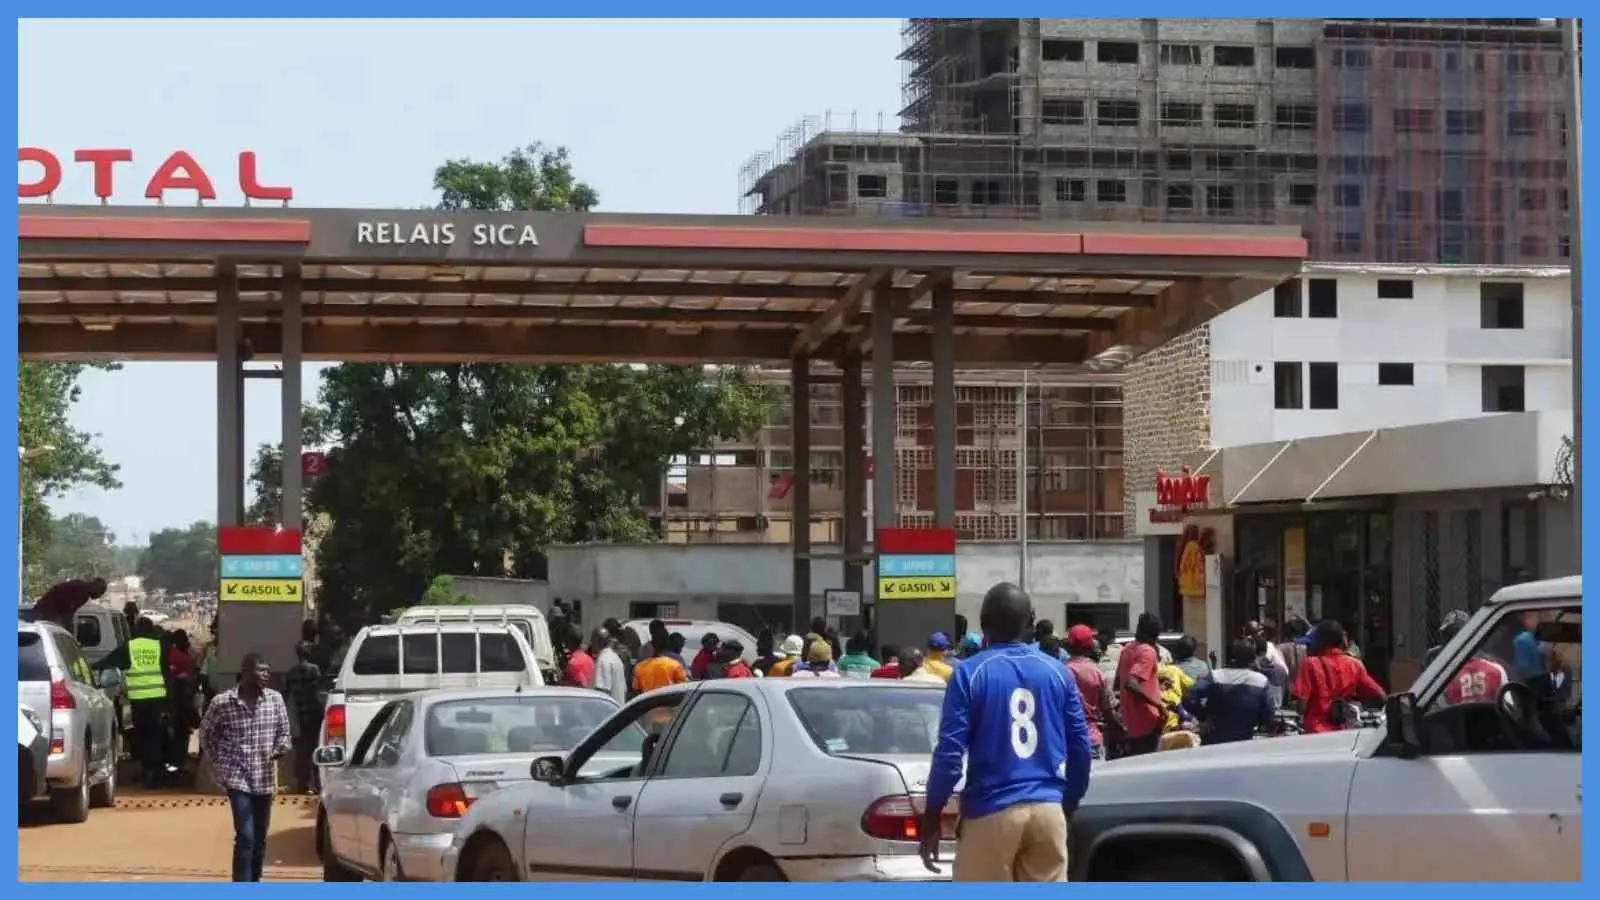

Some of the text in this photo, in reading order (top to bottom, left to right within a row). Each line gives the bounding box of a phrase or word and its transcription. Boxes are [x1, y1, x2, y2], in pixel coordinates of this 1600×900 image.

[357, 221, 539, 246] RELAIS SICA
[306, 456, 319, 472] 2
[241, 585, 281, 595] GASOIL
[899, 583, 936, 593] GASOIL
[1010, 687, 1038, 759] 8
